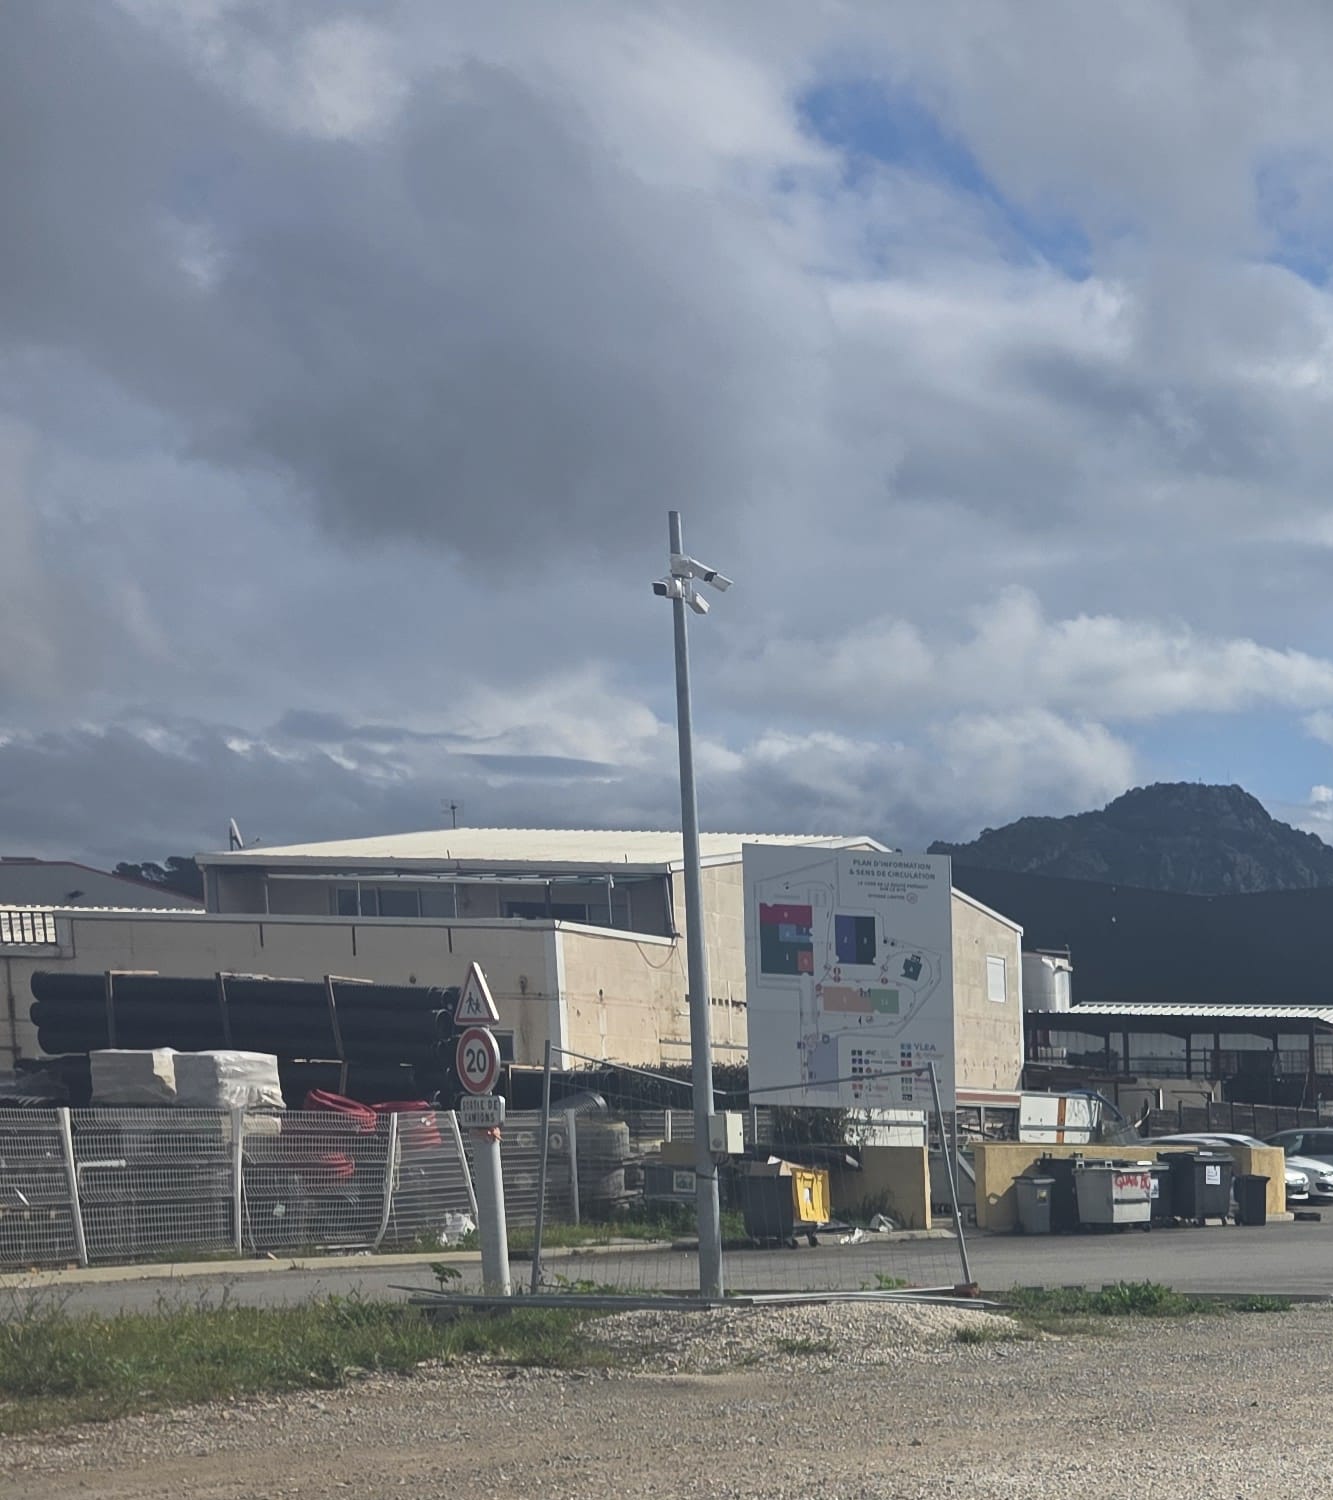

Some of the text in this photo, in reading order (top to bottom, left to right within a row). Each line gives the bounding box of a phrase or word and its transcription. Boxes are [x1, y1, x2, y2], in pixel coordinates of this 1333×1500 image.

[853, 859, 871, 867] PLAN
[887, 871, 936, 880] CIRCULATION
[466, 1048, 487, 1073] 20
[487, 1099, 498, 1110] DE
